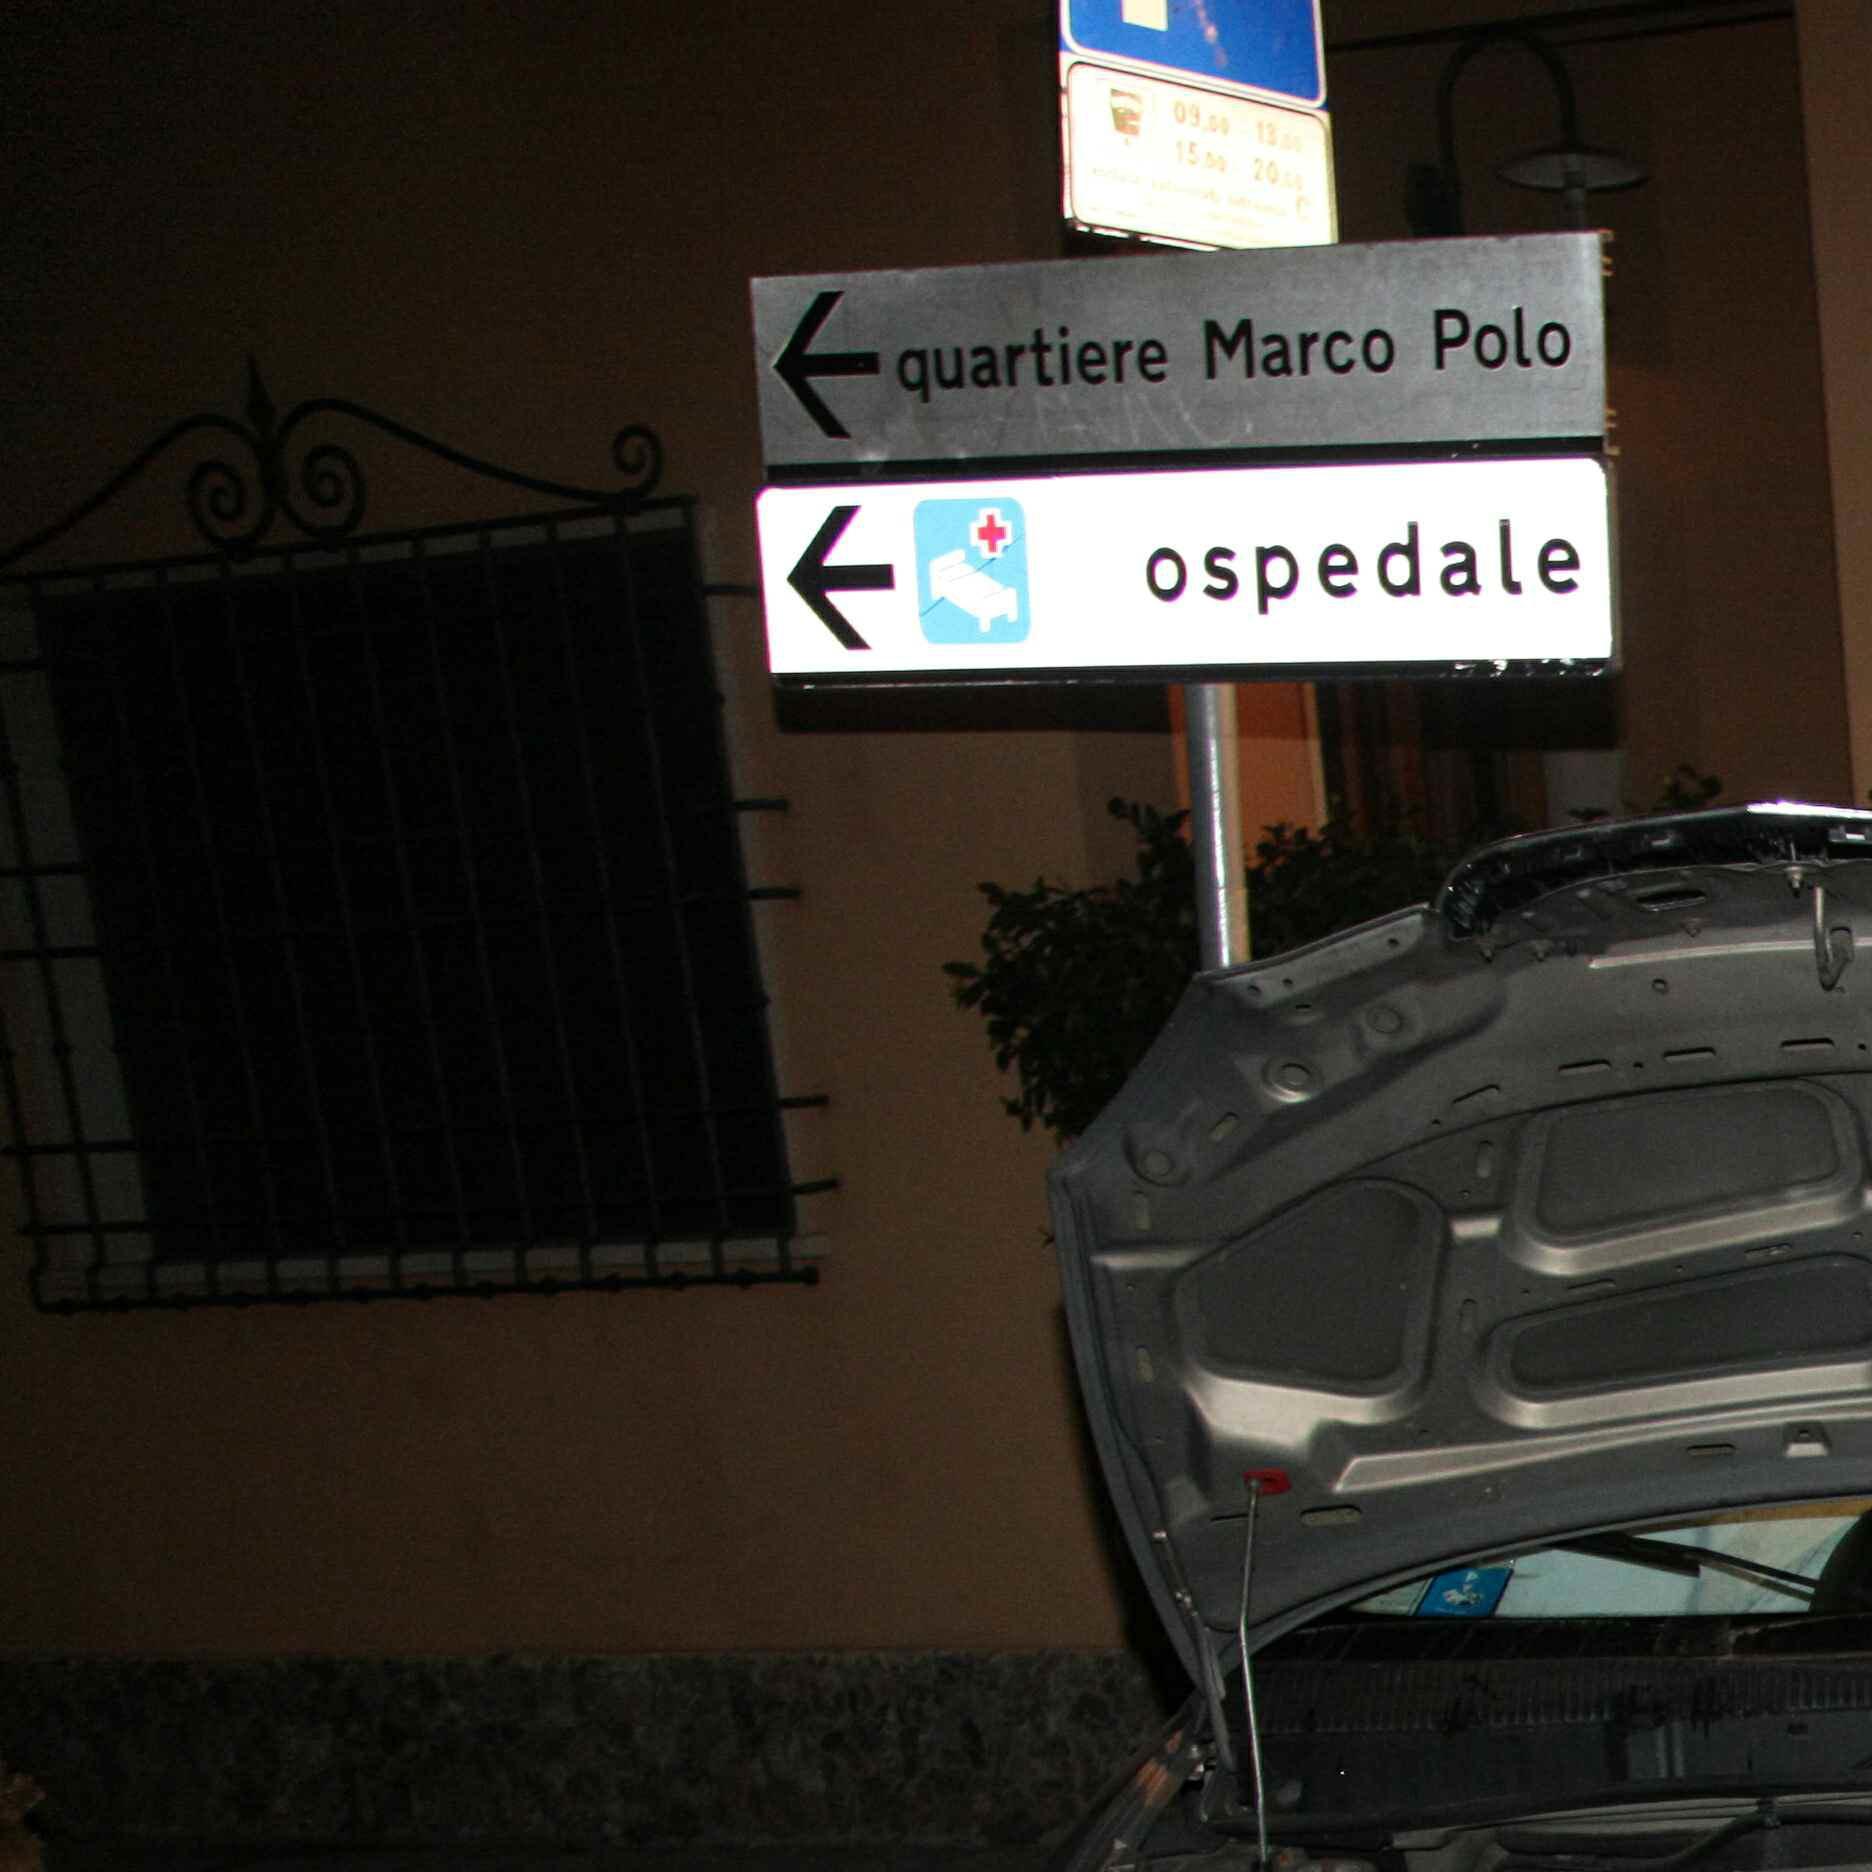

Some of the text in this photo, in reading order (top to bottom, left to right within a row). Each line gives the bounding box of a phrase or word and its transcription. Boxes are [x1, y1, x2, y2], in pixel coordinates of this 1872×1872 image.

[896, 306, 1573, 404] quartiere Marco Polo
[1146, 518, 1583, 616] ospedale
